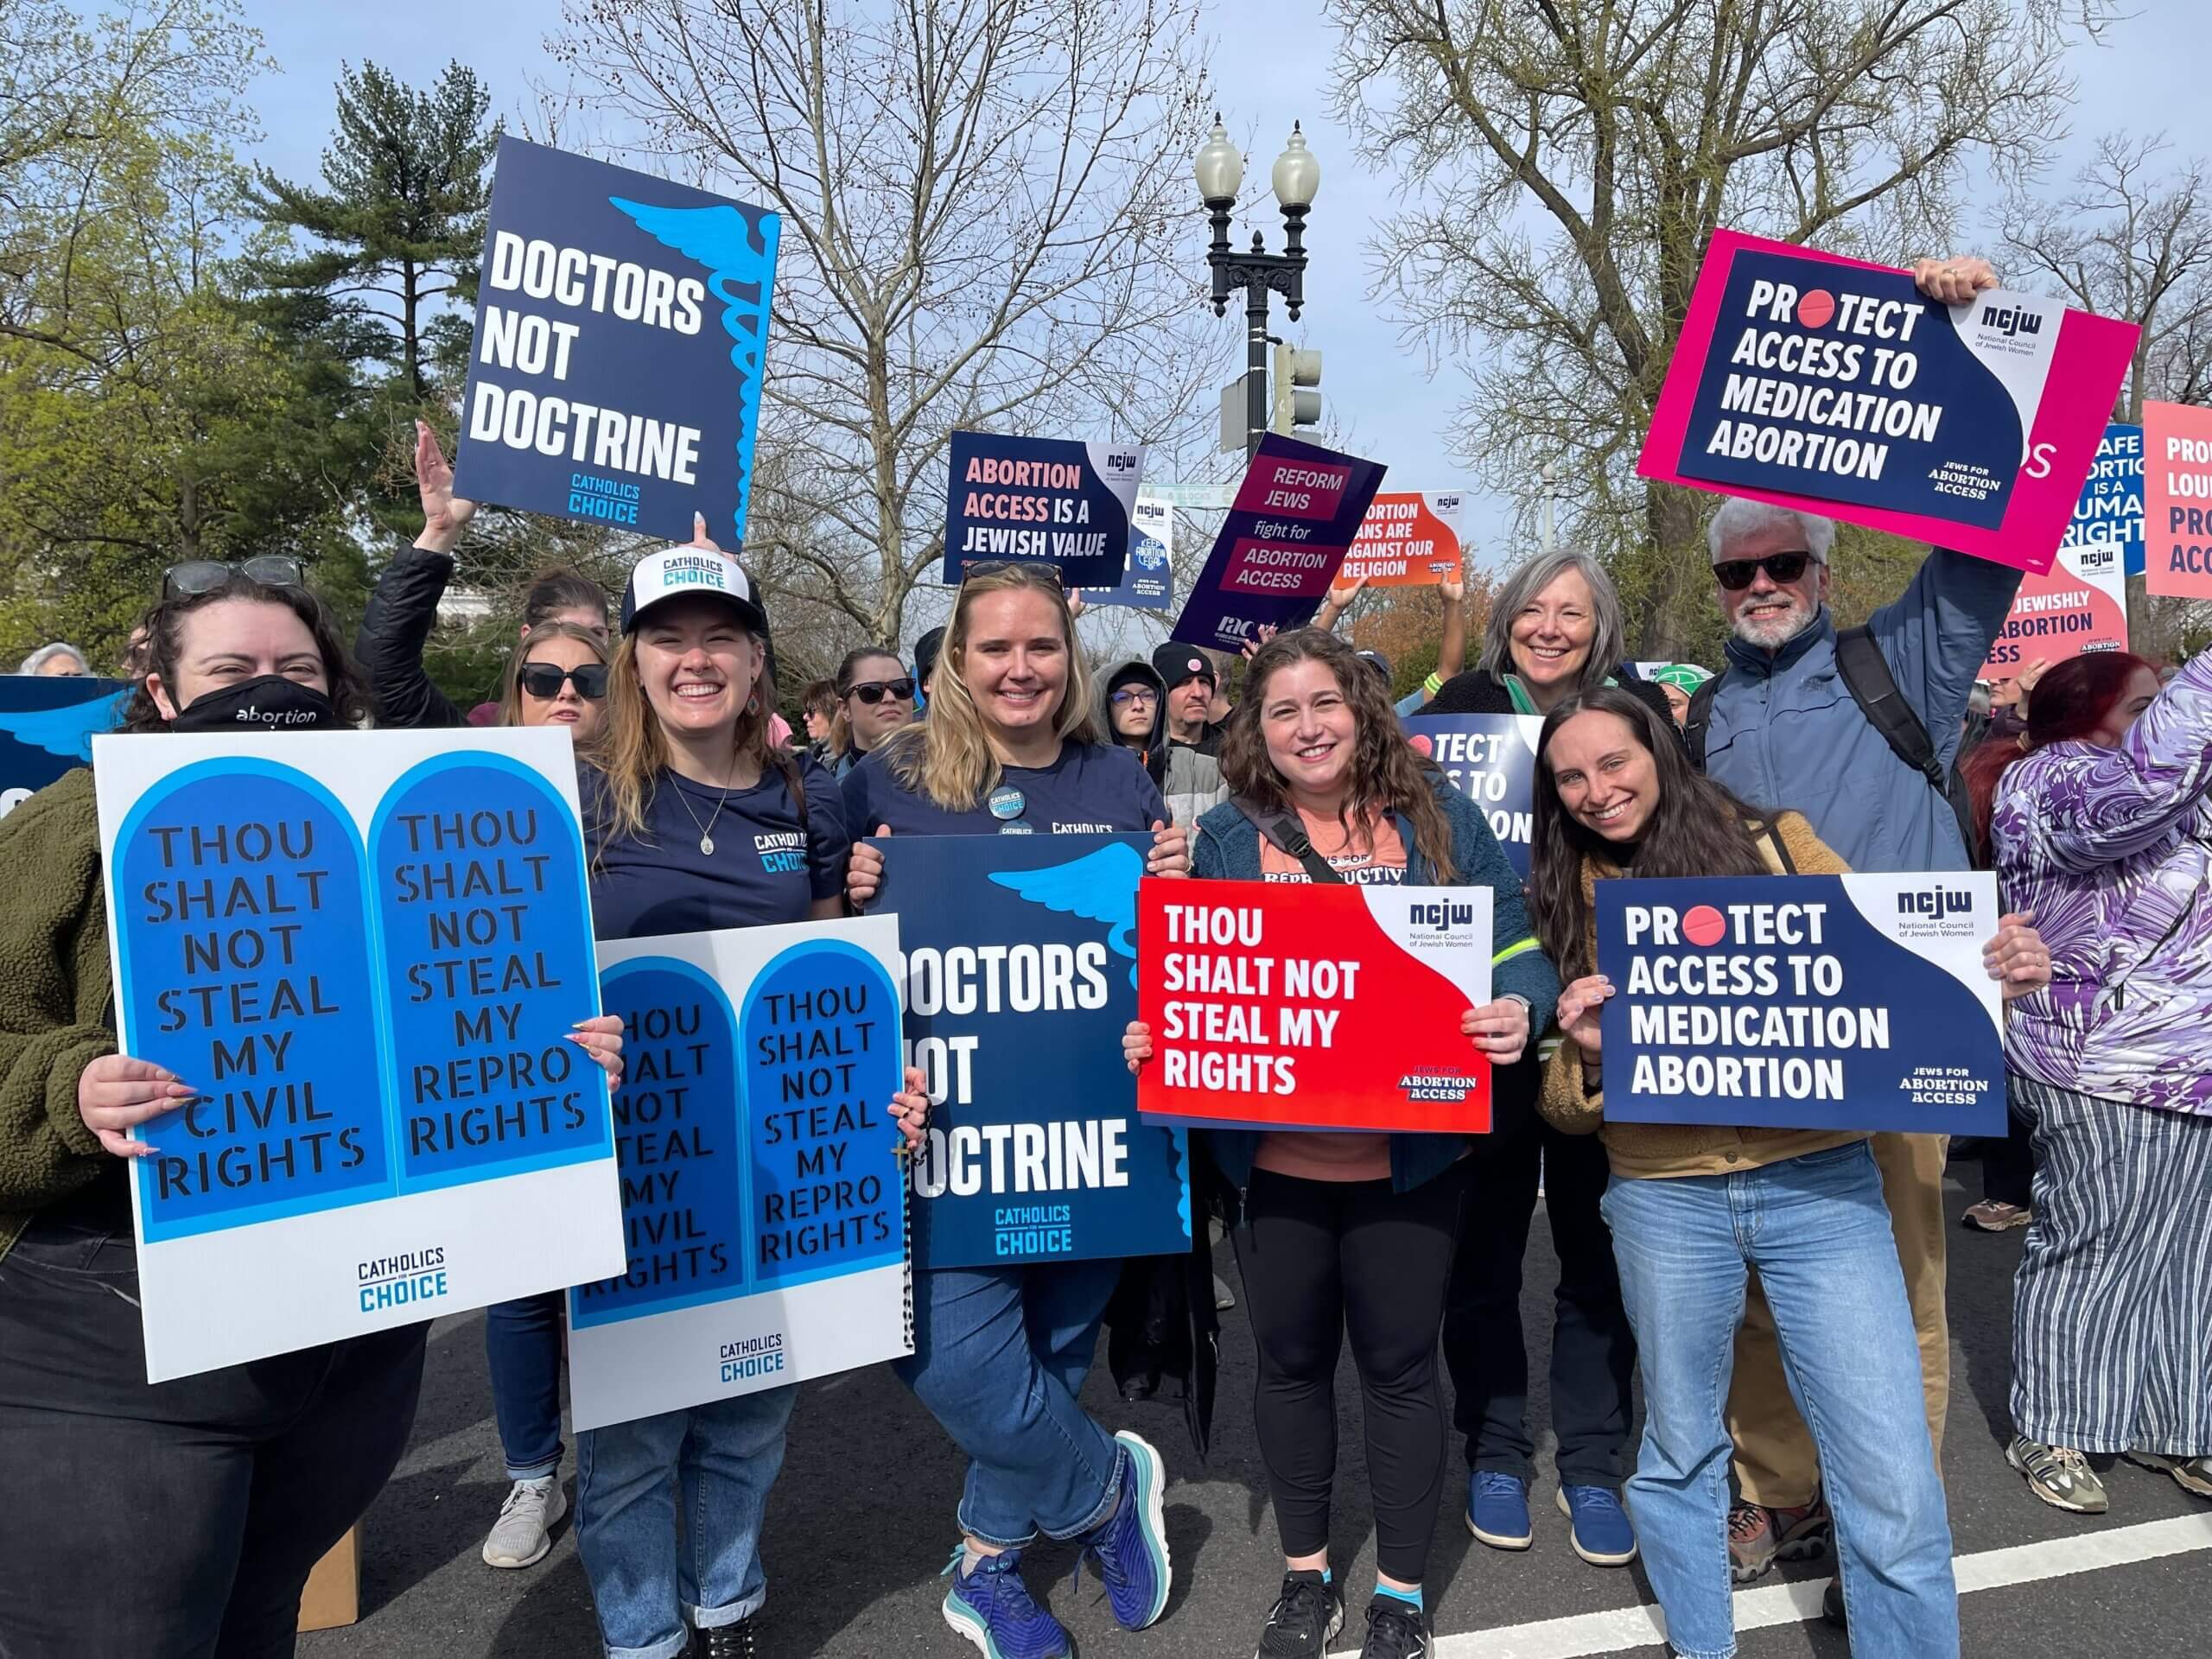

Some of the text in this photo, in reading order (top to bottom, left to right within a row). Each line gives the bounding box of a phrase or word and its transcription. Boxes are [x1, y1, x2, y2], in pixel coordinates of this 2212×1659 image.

[490, 230, 704, 335] DOCTORS
[1981, 305, 2043, 336] ncjw
[480, 305, 580, 381] NOT
[1977, 333, 2036, 349] National Council
[1984, 342, 2007, 352] Jewish
[2008, 346, 2034, 356] Women
[1731, 328, 1917, 390] ACCESS TO
[1720, 373, 1942, 443] MEDICATION
[469, 381, 701, 486] DOCTRINE
[2094, 435, 2139, 456] AFE
[1108, 452, 1136, 471] ncjw
[1707, 420, 1888, 481] ABORTION
[2166, 437, 2212, 464] PRO
[965, 457, 1081, 490] ABORTION
[1273, 467, 1344, 491] REFORM
[1928, 468, 2001, 492] ABORTION
[1943, 461, 1989, 476] JEWS FOR
[2086, 457, 2145, 480] ORTIO
[572, 474, 639, 499] CATHOLICS
[1264, 490, 1311, 510] JEWS
[1934, 482, 1987, 500] ACCESS
[2094, 480, 2125, 495] IS A
[2168, 472, 2212, 498] LOU
[569, 493, 639, 524] CHOICE
[963, 492, 1090, 524] ACCESS IS A
[1137, 503, 1164, 518] ncjw
[1365, 503, 1418, 520] ORTION
[1437, 495, 1459, 508] ncjw
[2074, 494, 2144, 519] UMA
[962, 527, 1107, 556] JEWISH VALUE
[1141, 538, 1161, 547] KEEP
[1254, 520, 1311, 540] fight for
[1354, 523, 1413, 539] ANS ARE
[664, 557, 722, 572] CATHOLICS
[1135, 546, 1166, 558] ABORTION
[1243, 548, 1327, 569] ABORTION
[1344, 540, 1433, 558] AGAINST OUR
[2081, 550, 2113, 567] ncjw
[664, 571, 726, 589] CHOICE
[1236, 569, 1303, 589] ACCESS
[1343, 560, 1407, 578] RELIGION
[2014, 590, 2090, 614] JEWISHLY
[1217, 616, 1255, 637] rac
[1987, 645, 2021, 664] ESS
[2082, 641, 2121, 651] ABORTION
[236, 706, 316, 724] abortion
[990, 791, 1020, 804] CATHOLICS
[1469, 770, 1507, 802] TO
[993, 800, 1024, 813] CHOICE
[149, 820, 314, 868] THOU
[397, 809, 537, 853] THOU
[753, 832, 807, 850] CATHOLI
[760, 852, 809, 873] CHOI
[1343, 855, 1369, 863] FOR
[396, 855, 550, 904] SHALT
[143, 871, 329, 924] SHALT
[1897, 885, 1972, 919] ncjw
[430, 906, 528, 950] NOT
[1164, 905, 1262, 947] THOU
[1410, 898, 1472, 931] ncjw
[184, 925, 302, 975] NOT
[408, 956, 561, 1003] STEAL
[1163, 953, 1360, 1000] SHALT NOT
[1626, 955, 1843, 996] ACCESS TO
[158, 975, 339, 1033] STEAL
[763, 984, 867, 1026] THOU
[455, 1002, 523, 1047] MY
[625, 1004, 701, 1042] HOU
[1163, 1001, 1340, 1048] STEAL MY
[1630, 1006, 1890, 1049] MEDICATION
[212, 1031, 294, 1080] MY
[759, 1021, 876, 1067] SHALT
[415, 1047, 571, 1104] REPRO
[621, 1043, 710, 1085] ALT
[1164, 1049, 1296, 1095] RIGHTS
[1630, 1055, 1845, 1100] ABORTION
[1913, 1067, 1969, 1077] JEWS FOR
[782, 1064, 856, 1103] NOT
[1401, 1075, 1477, 1088] ABORTION
[1410, 1088, 1466, 1100] ACCESS
[1899, 1077, 1988, 1091] ABORTION
[183, 1081, 334, 1139] CIVIL
[612, 1087, 689, 1127] NOT
[1911, 1091, 1976, 1104] ACCESS
[410, 1092, 585, 1158] RIGHTS
[765, 1103, 878, 1147] STEAL
[615, 1126, 714, 1169] TEAL
[798, 1141, 849, 1179] MY
[909, 1119, 1128, 1198] OCTRINE
[158, 1127, 365, 1200] RIGHTS
[623, 1170, 679, 1209] MY
[766, 1175, 881, 1224] REPRO
[631, 1209, 706, 1249] IVIL
[995, 1205, 1070, 1224] CATHOLICS
[761, 1211, 889, 1265] RIGHTS
[995, 1230, 1071, 1255] CHOICE
[359, 1247, 444, 1280] CATHOLICS
[359, 1272, 448, 1313] CHOICE
[721, 1333, 782, 1358] CATHOLICS
[721, 1352, 784, 1382] CHOICE
